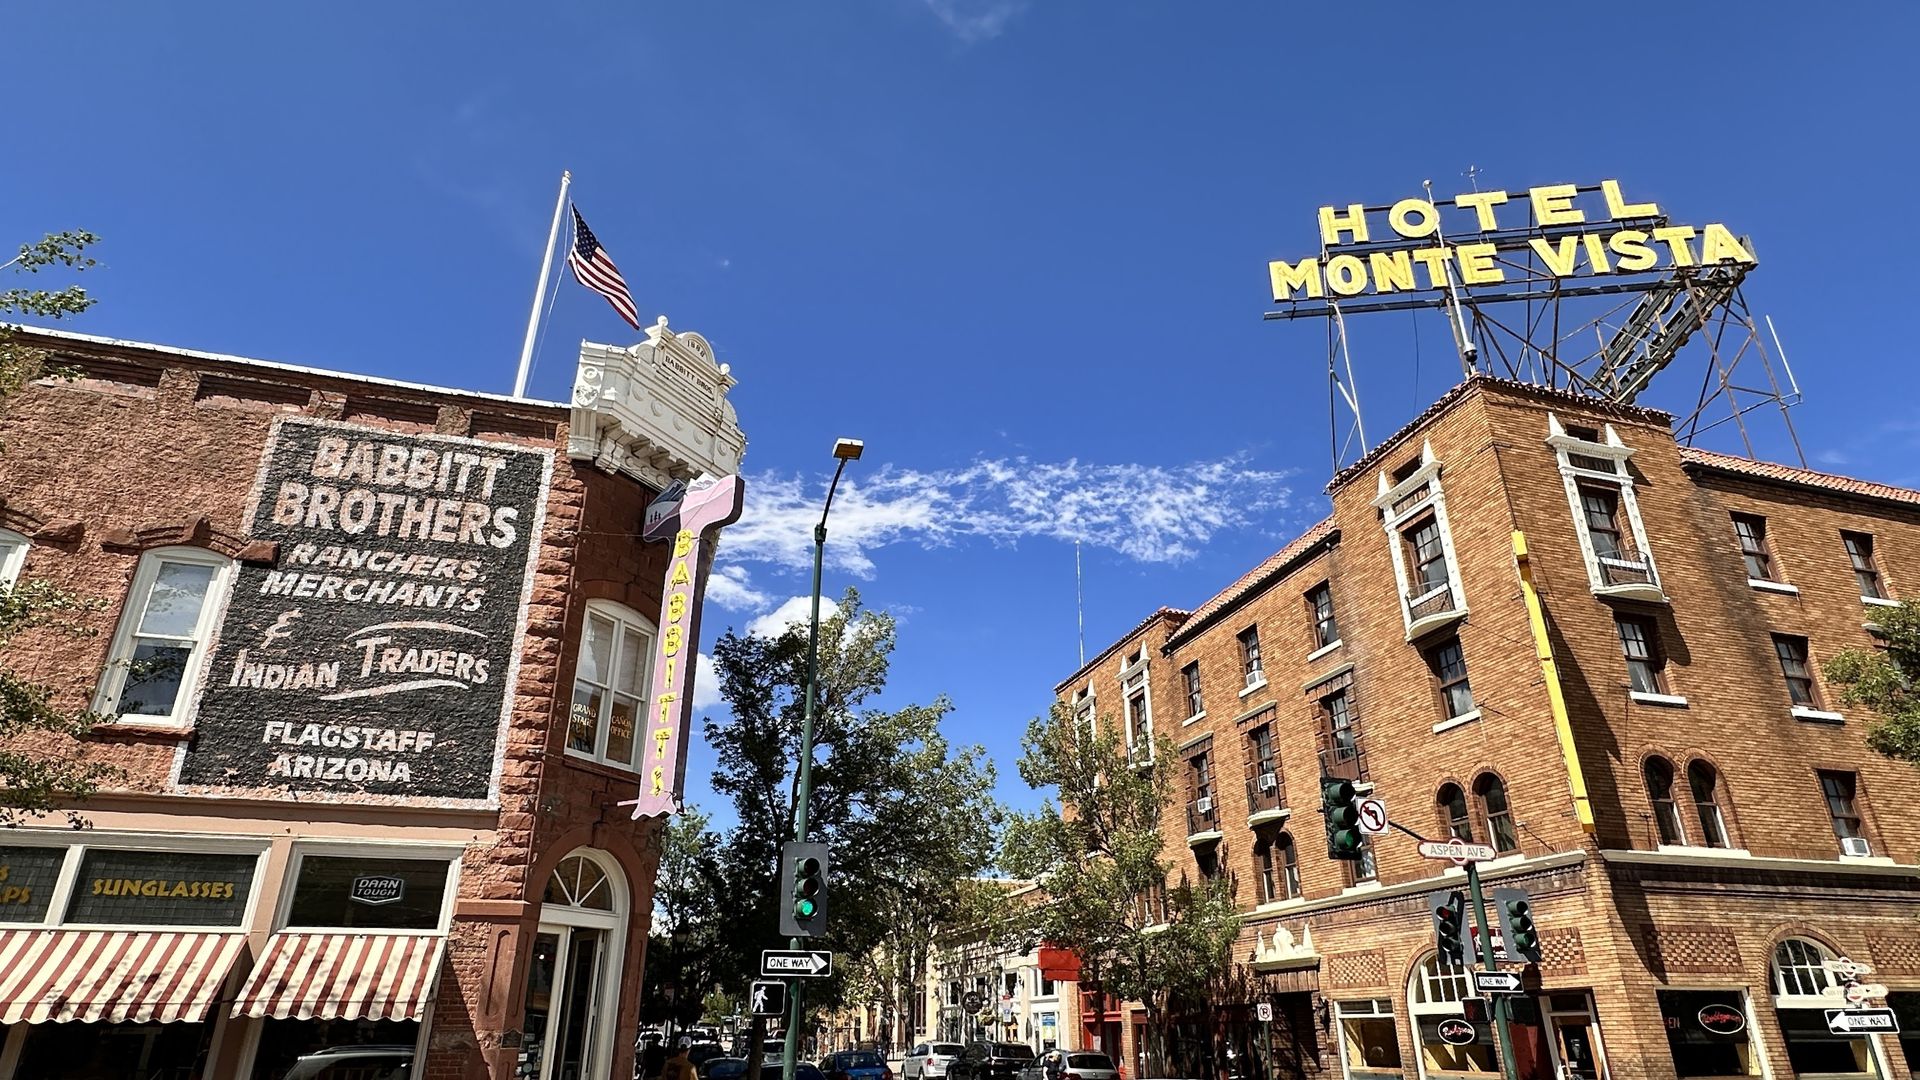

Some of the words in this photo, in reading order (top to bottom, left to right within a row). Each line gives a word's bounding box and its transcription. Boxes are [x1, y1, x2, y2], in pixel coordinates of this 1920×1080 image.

[1319, 179, 1659, 245] HOTEL
[1268, 243, 1505, 301] MONTE
[1529, 223, 1754, 277] VISTA
[665, 356, 696, 381] BABBITT
[311, 434, 506, 500] BABBITT
[272, 480, 517, 549] BROTHERS
[259, 571, 486, 612] MERCHANTS
[229, 648, 341, 690] INDIAN
[355, 635, 490, 686] TRADERS
[573, 703, 597, 718] GRAND
[262, 720, 435, 753] FLAGSTAFF
[267, 754, 411, 783] ARIZONA
[1430, 844, 1462, 856] ASPEN
[1467, 846, 1486, 857] AVE
[92, 878, 234, 899] SUNGLASSES
[357, 888, 397, 896] TOUGH
[359, 879, 399, 889] DARN
[770, 958, 788, 968] ONE
[792, 959, 810, 968] WAY
[1480, 977, 1494, 986] ONE
[1495, 978, 1508, 986] WAY
[1847, 1016, 1867, 1026] ONE
[1869, 1016, 1887, 1026] WAY
